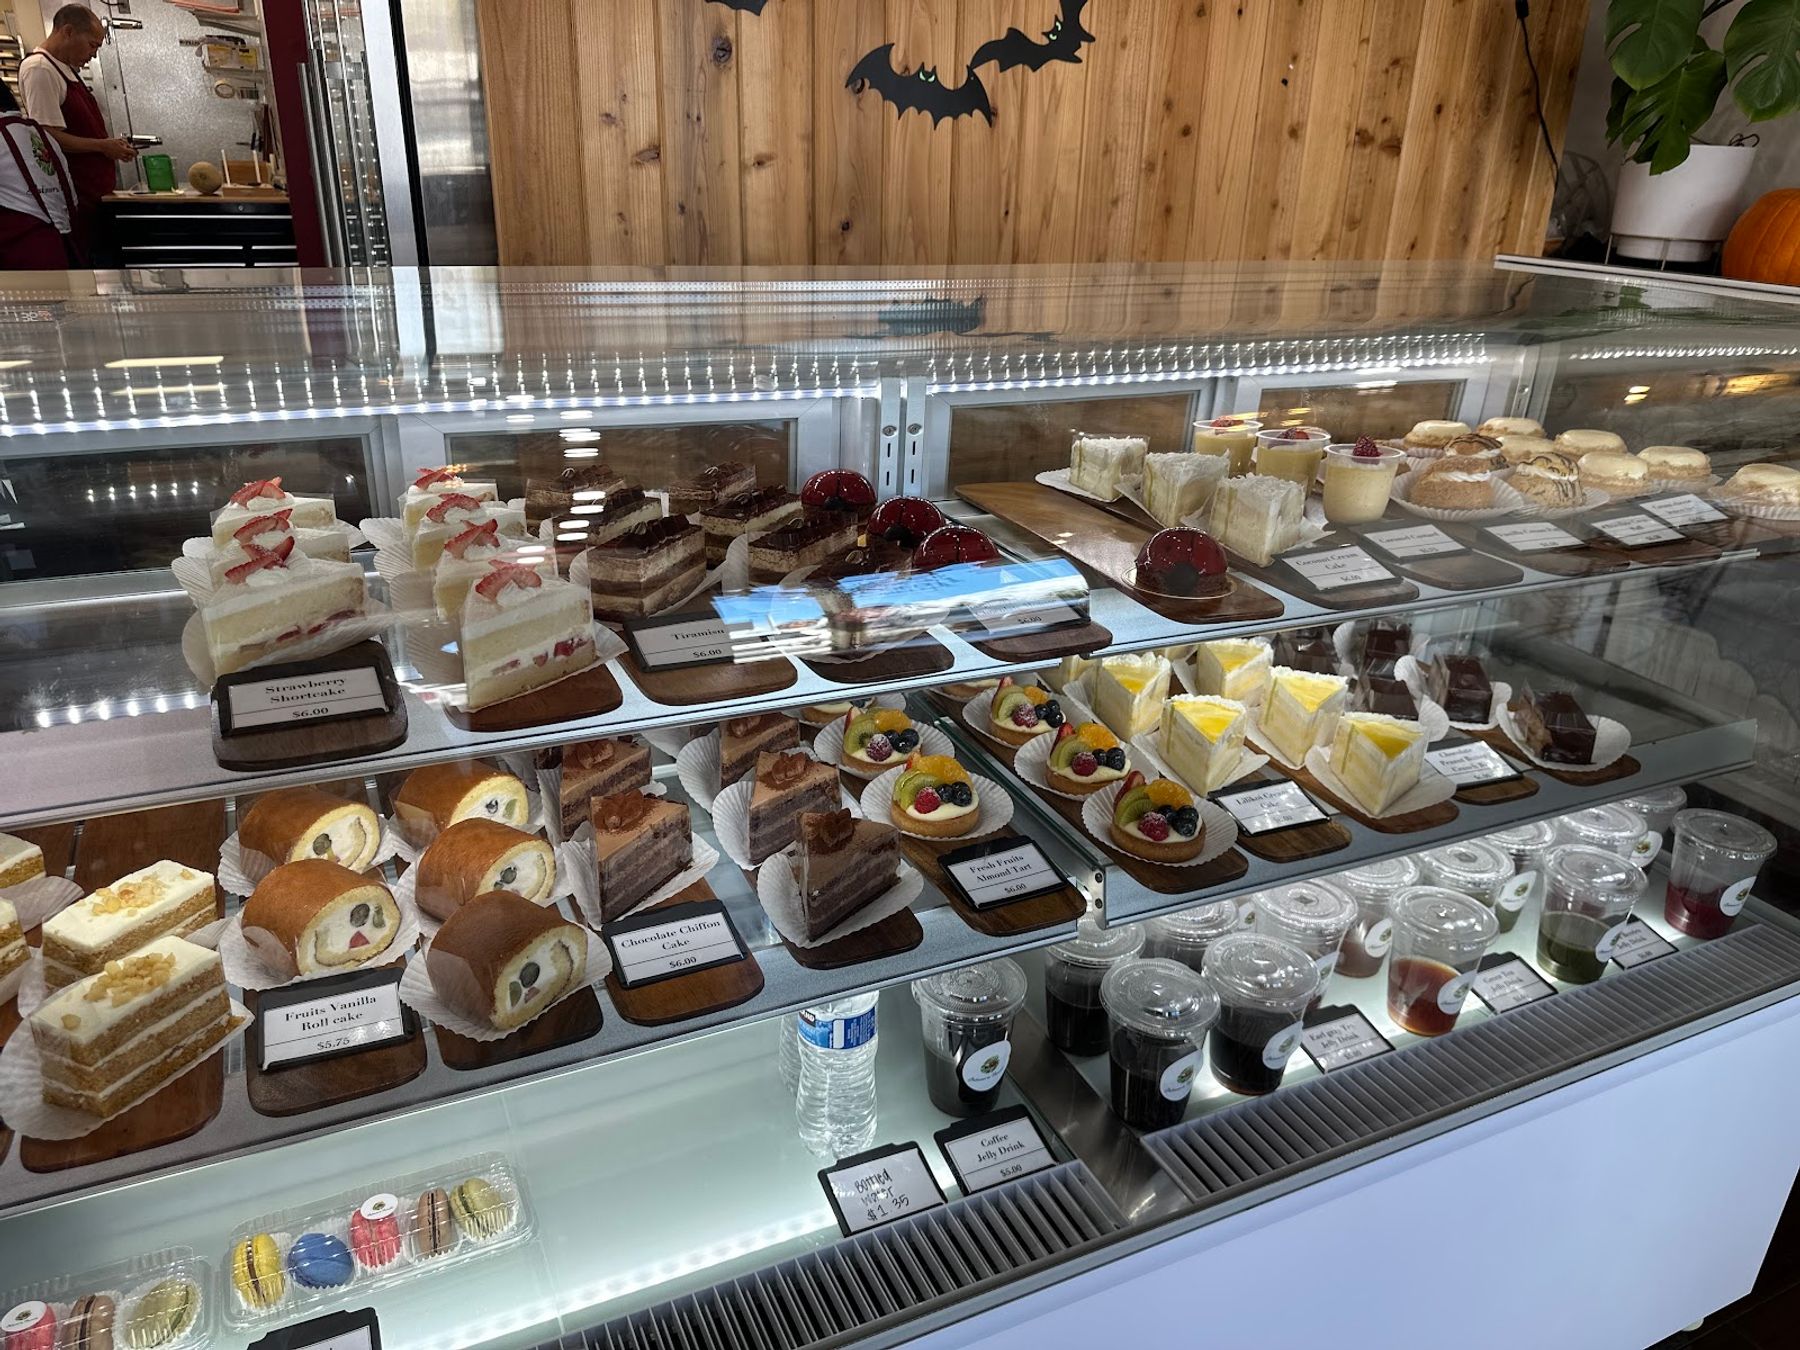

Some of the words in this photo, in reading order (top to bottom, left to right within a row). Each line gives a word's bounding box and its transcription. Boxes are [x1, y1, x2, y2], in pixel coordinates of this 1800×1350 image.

[1330, 552, 1359, 560] Cream
[692, 648, 722, 658] $6.00
[265, 677, 347, 694] Strawberry
[270, 687, 346, 704] Shortcake
[292, 707, 329, 718] $6.00
[969, 861, 996, 874] Fresh
[996, 855, 1024, 867] Fruits
[976, 868, 1011, 882] Almond
[1011, 863, 1032, 873] Tart
[1004, 883, 1028, 894] $6.00
[621, 930, 677, 949] Chocolate
[679, 920, 721, 935] Chiffon
[662, 939, 690, 951] Cake
[669, 956, 697, 969] $6.00
[285, 1007, 326, 1022] Fruits
[330, 996, 377, 1011] Vanilla
[302, 1018, 329, 1031] Roll
[333, 1012, 363, 1025] cake
[317, 1037, 350, 1051] $5.75
[1337, 1032, 1360, 1043] Drink
[980, 1133, 1009, 1147] Coffee
[977, 1151, 998, 1162] Jelly
[998, 1140, 1025, 1156] Drink
[1000, 1163, 1023, 1177] $5.00
